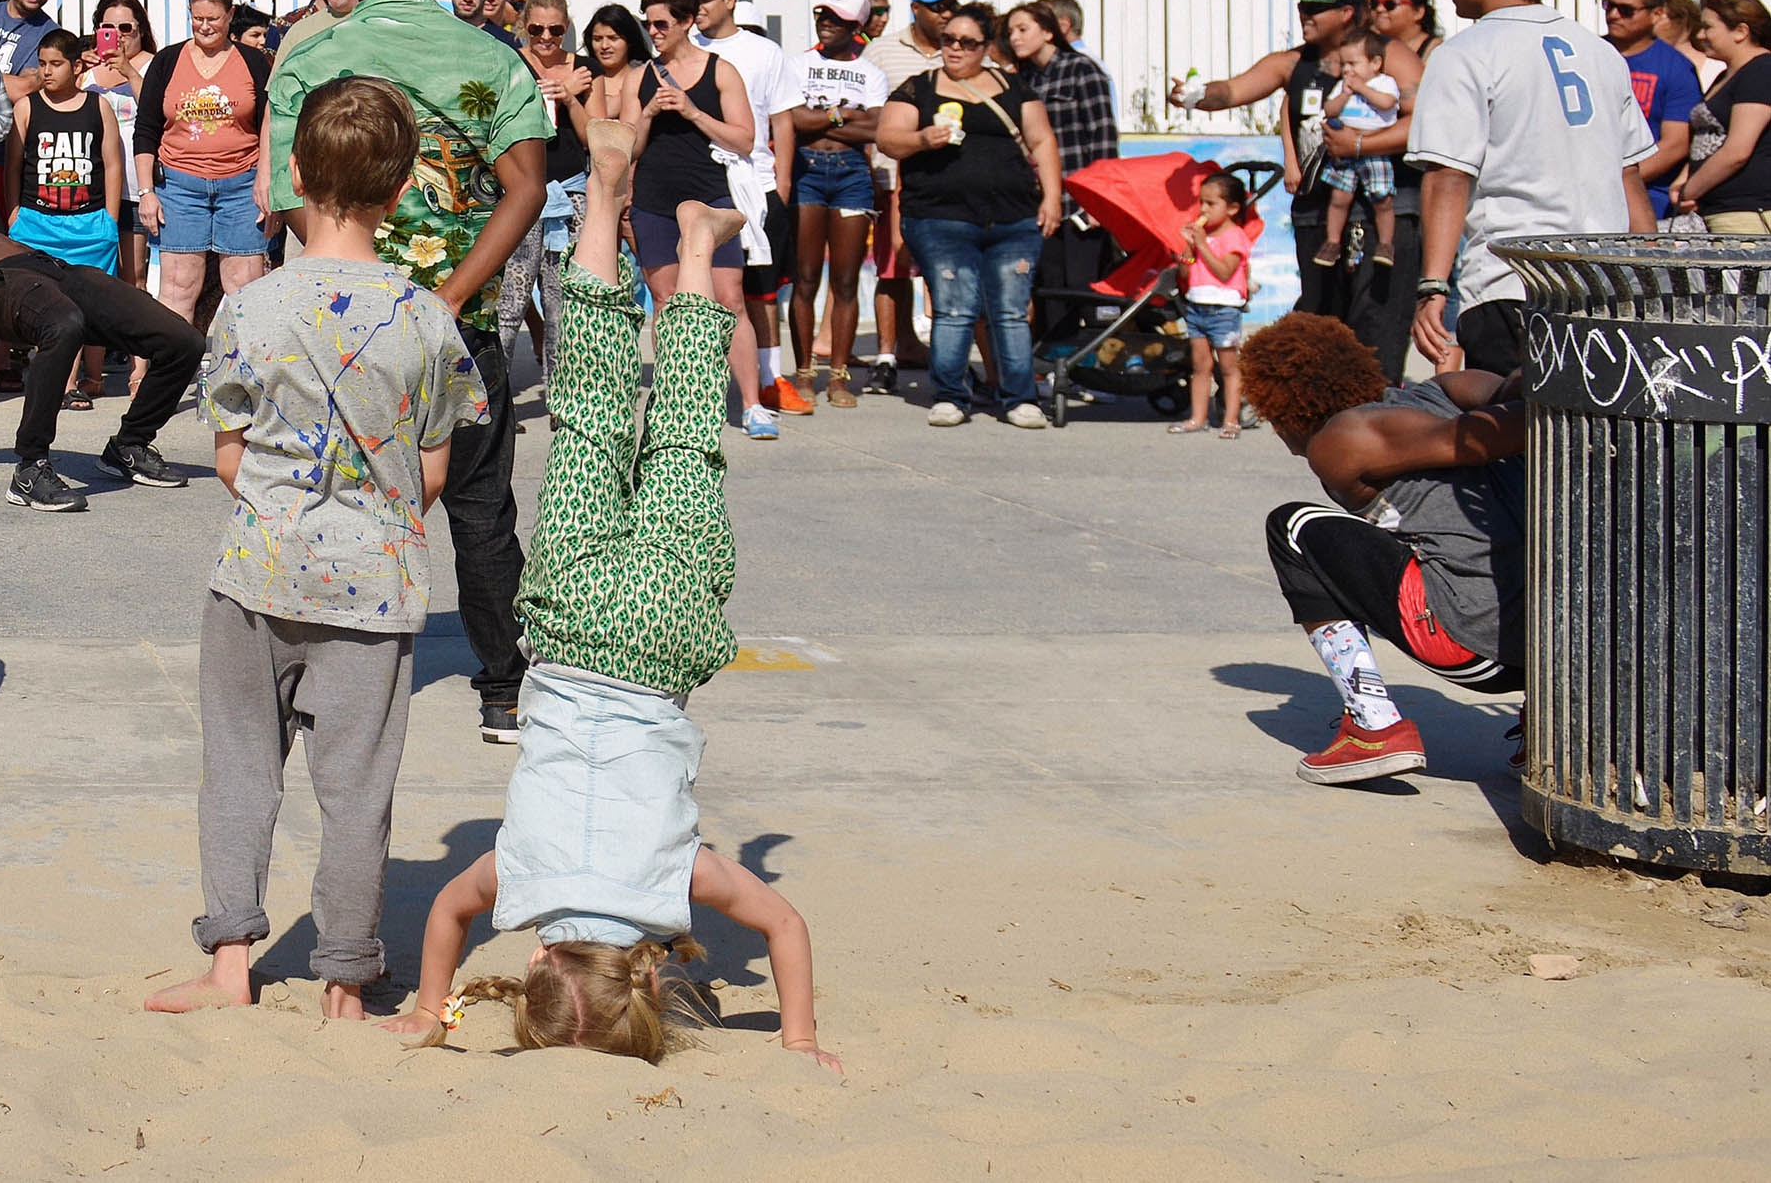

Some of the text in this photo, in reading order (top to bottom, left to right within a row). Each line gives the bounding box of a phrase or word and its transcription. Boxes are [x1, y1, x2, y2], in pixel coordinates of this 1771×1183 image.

[808, 66, 867, 85] THE BEATLES
[1540, 35, 1597, 129] 6
[37, 132, 94, 159] CALI
